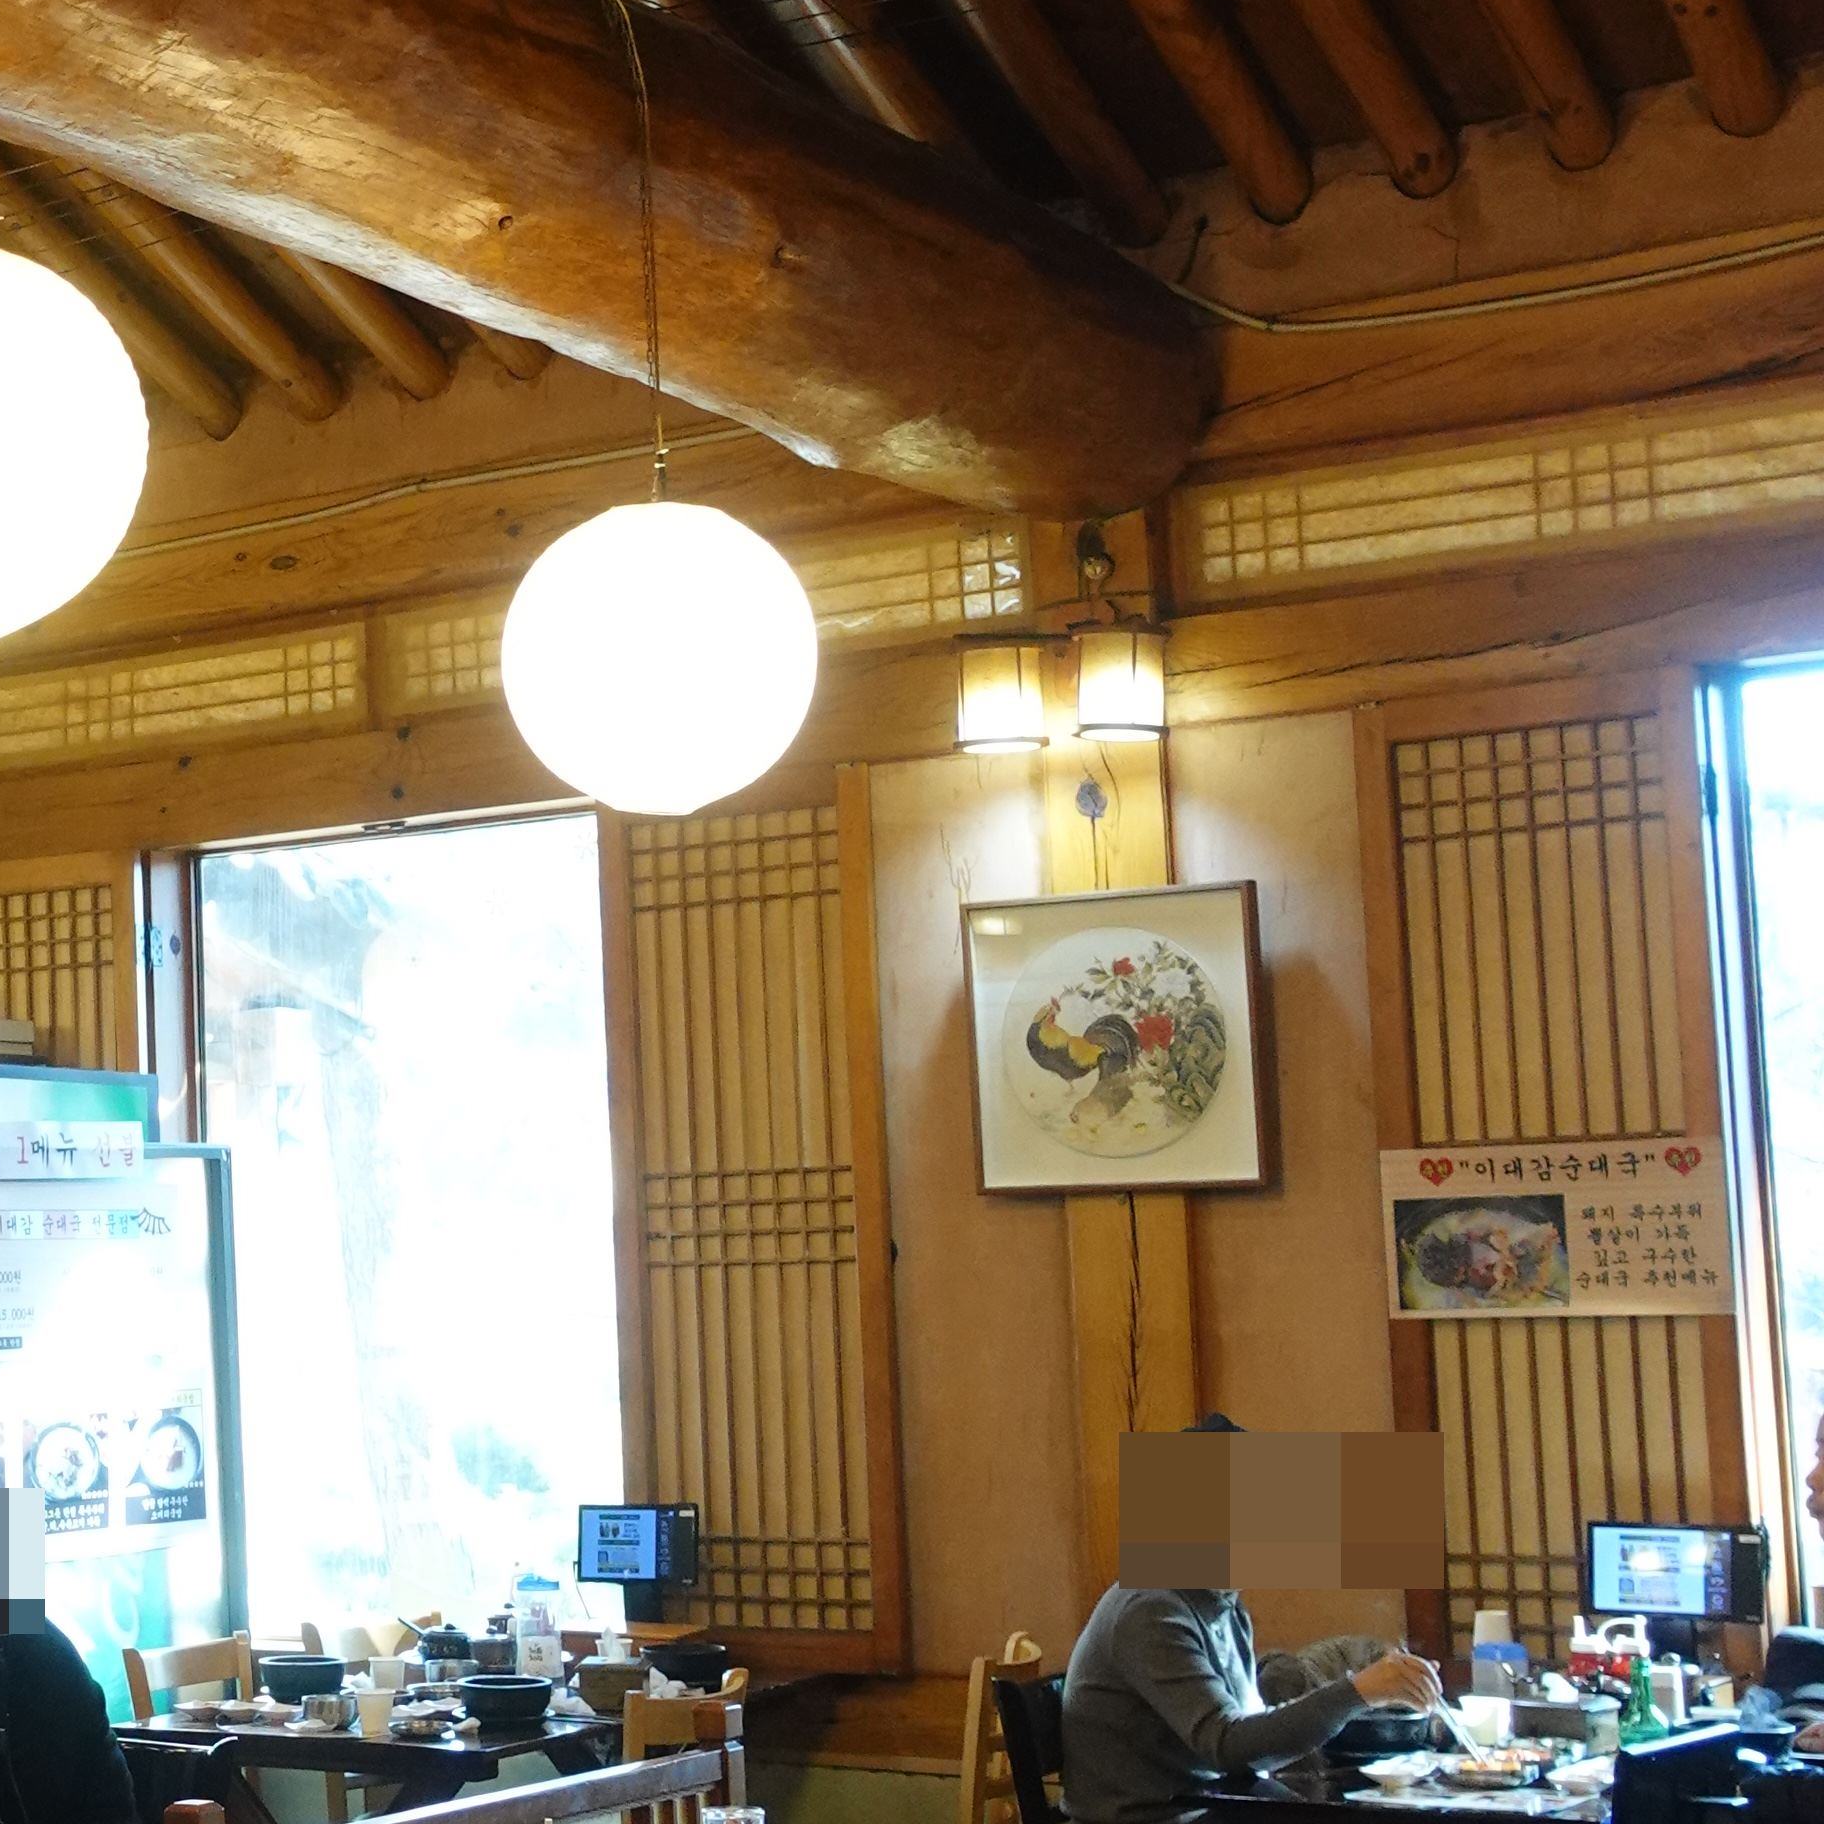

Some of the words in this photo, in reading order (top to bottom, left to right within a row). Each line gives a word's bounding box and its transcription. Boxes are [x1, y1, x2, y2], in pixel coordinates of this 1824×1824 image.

[17, 1131, 78, 1168] 1메뉴
[43, 1214, 82, 1236] 순대국
[1656, 1224, 1690, 1241] 가득
[1641, 1245, 1697, 1265] 구수한
[1576, 1269, 1630, 1290] 순대국
